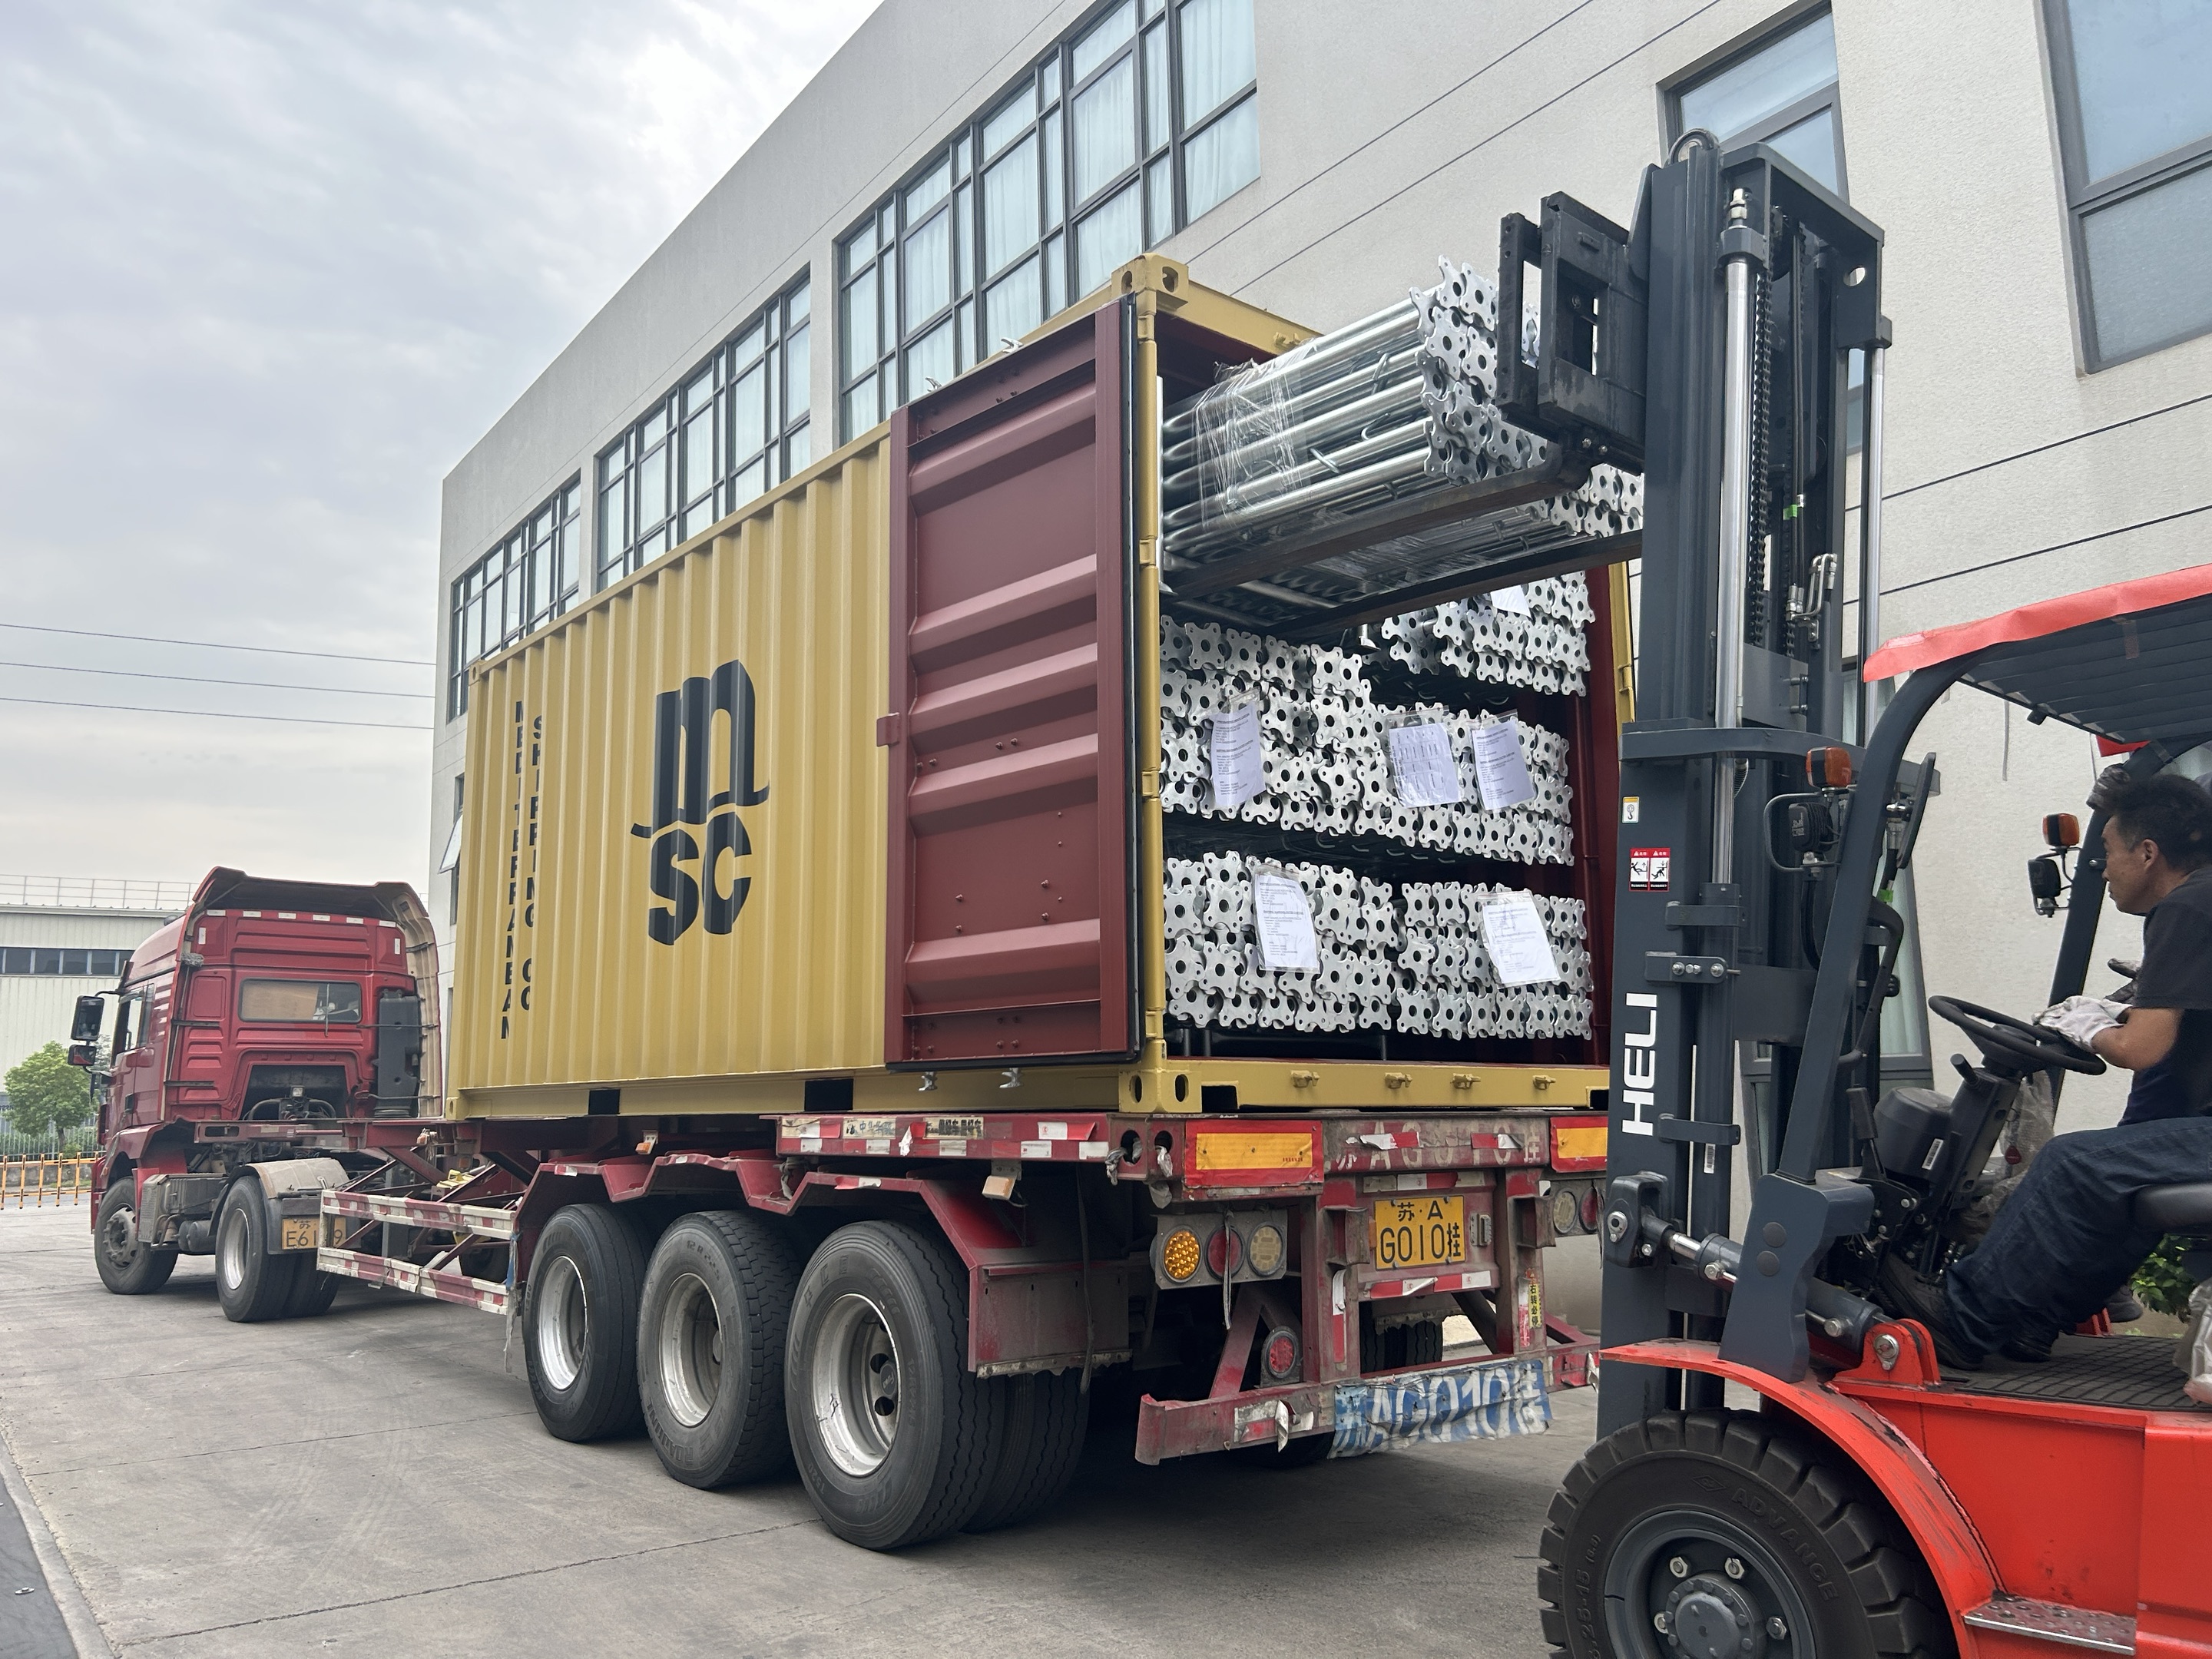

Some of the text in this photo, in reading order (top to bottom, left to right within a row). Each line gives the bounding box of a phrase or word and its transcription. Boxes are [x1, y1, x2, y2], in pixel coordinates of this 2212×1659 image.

[1622, 993, 1657, 1136] HELI
[286, 1229, 343, 1247] E619
[1380, 1222, 1461, 1263] G010挂
[1731, 1487, 1839, 1601] ADVANCE
